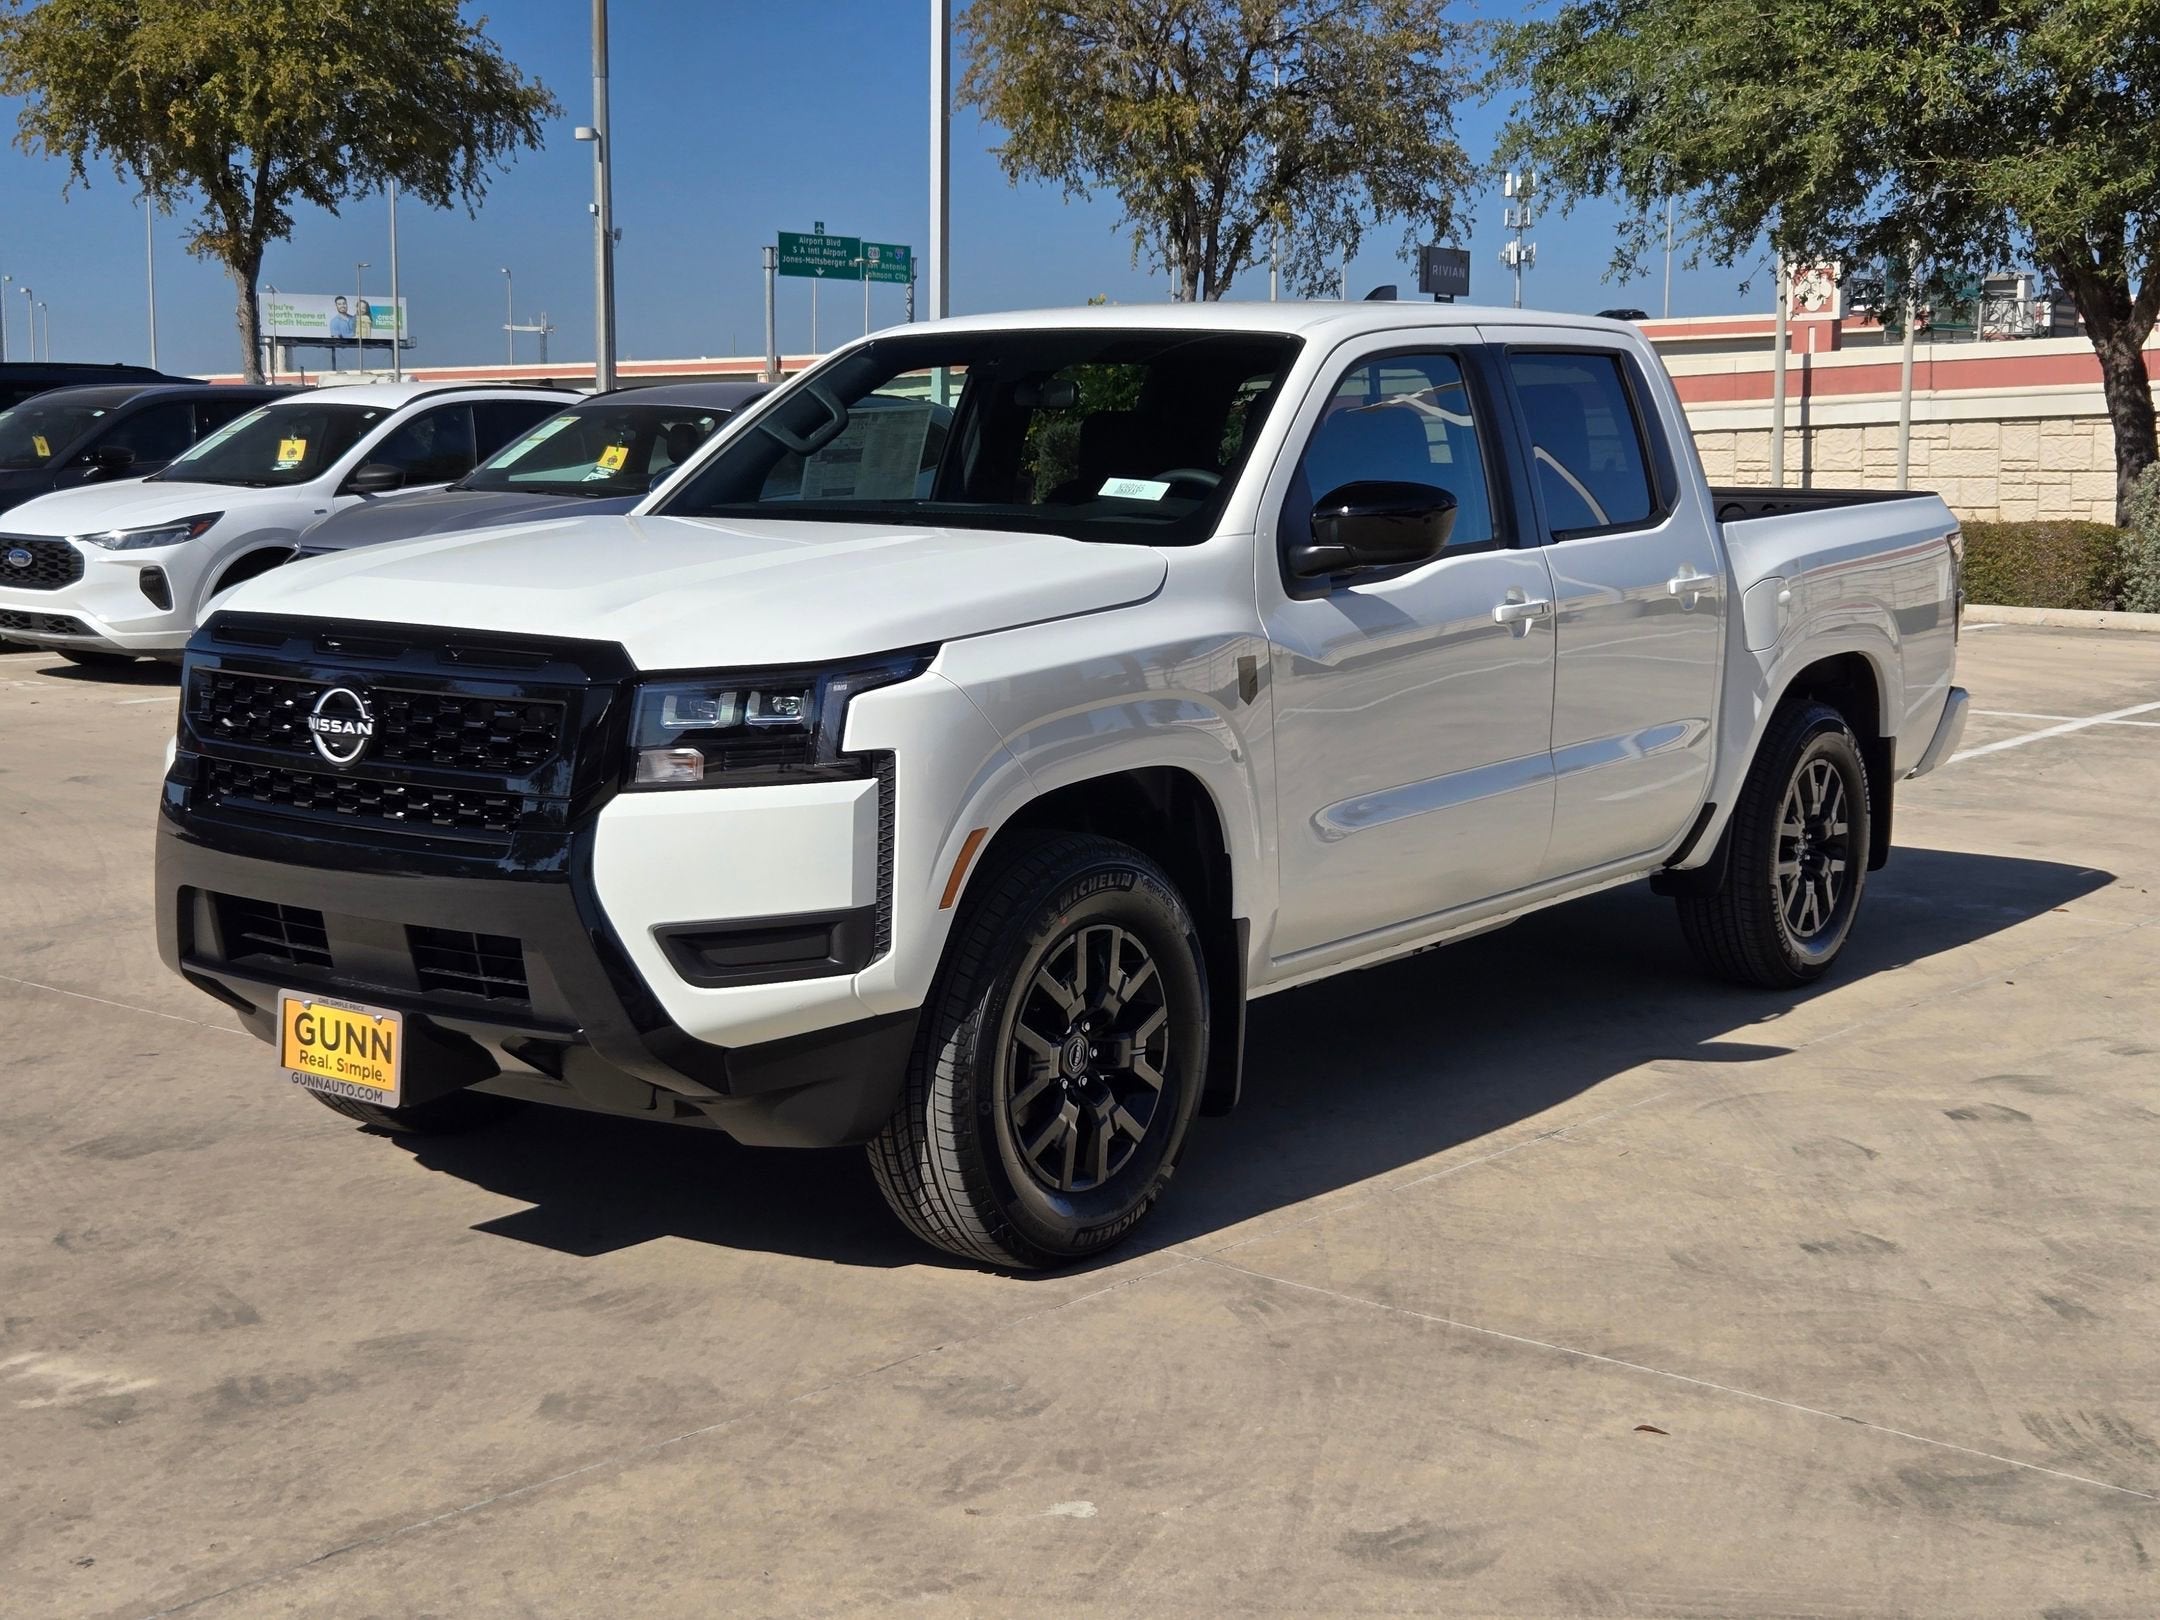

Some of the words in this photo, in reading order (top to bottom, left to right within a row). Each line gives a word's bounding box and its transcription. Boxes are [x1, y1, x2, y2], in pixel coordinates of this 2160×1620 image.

[798, 236, 823, 246] Airport
[826, 238, 841, 247] Blvd
[792, 246, 798, 254] S
[800, 246, 806, 254] A
[823, 247, 847, 257] Airport
[881, 262, 907, 272] Antonio
[1432, 264, 1466, 279] RIVIAN
[866, 271, 893, 280] ohnson
[895, 272, 908, 282] City
[268, 303, 295, 311] You're
[308, 716, 373, 735] NISSAN
[1059, 872, 1134, 911] MICHELIN
[294, 1011, 392, 1065] GUNN
[299, 1049, 333, 1071] Real.
[291, 1071, 383, 1103] GUNNAUTO.COM
[1074, 1199, 1148, 1246] MICHELIN
